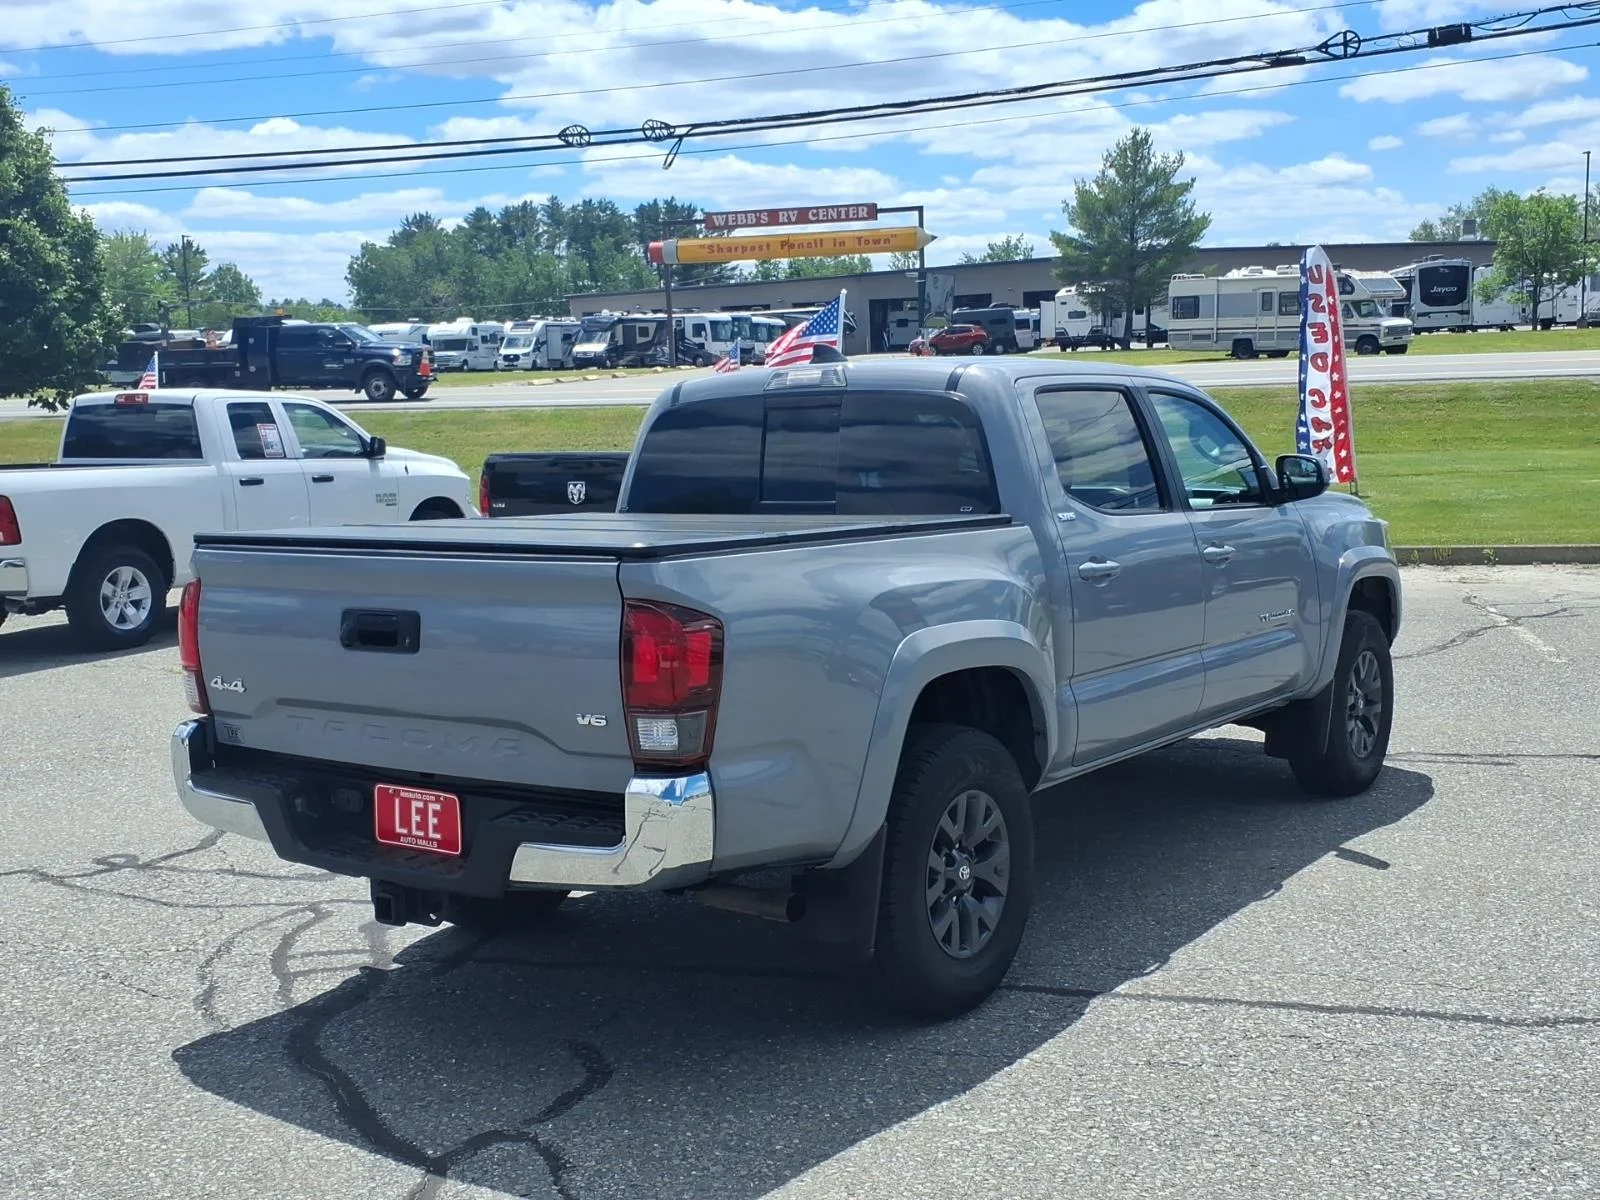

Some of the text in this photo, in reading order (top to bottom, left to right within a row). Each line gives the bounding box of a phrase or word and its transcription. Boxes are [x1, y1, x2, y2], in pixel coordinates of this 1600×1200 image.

[711, 206, 868, 226] WEBB'S RV CENTER
[700, 234, 897, 255] "Sharpest Pencil in Town"
[1430, 286, 1458, 294] Jayco
[575, 713, 607, 727] V6
[395, 798, 441, 839] LEE
[400, 836, 438, 848] AUTO MALLS
